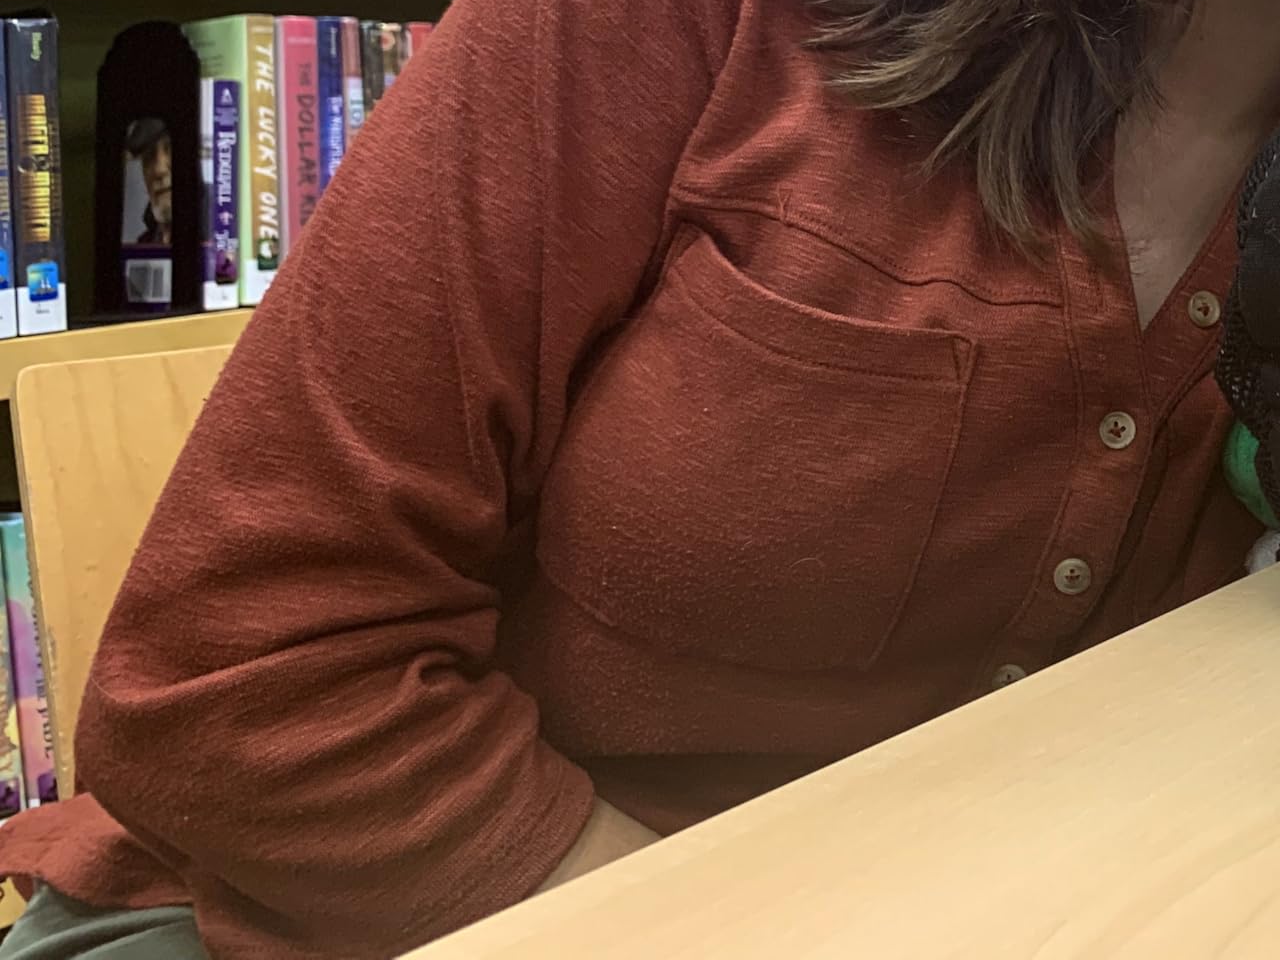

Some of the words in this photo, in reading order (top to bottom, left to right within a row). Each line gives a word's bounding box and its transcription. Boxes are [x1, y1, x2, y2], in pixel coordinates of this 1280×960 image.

[254, 44, 276, 92] THE
[299, 62, 312, 87] THE
[254, 106, 277, 179] LUCKY
[297, 93, 317, 187] DOLLAR
[258, 191, 280, 242] ONE
